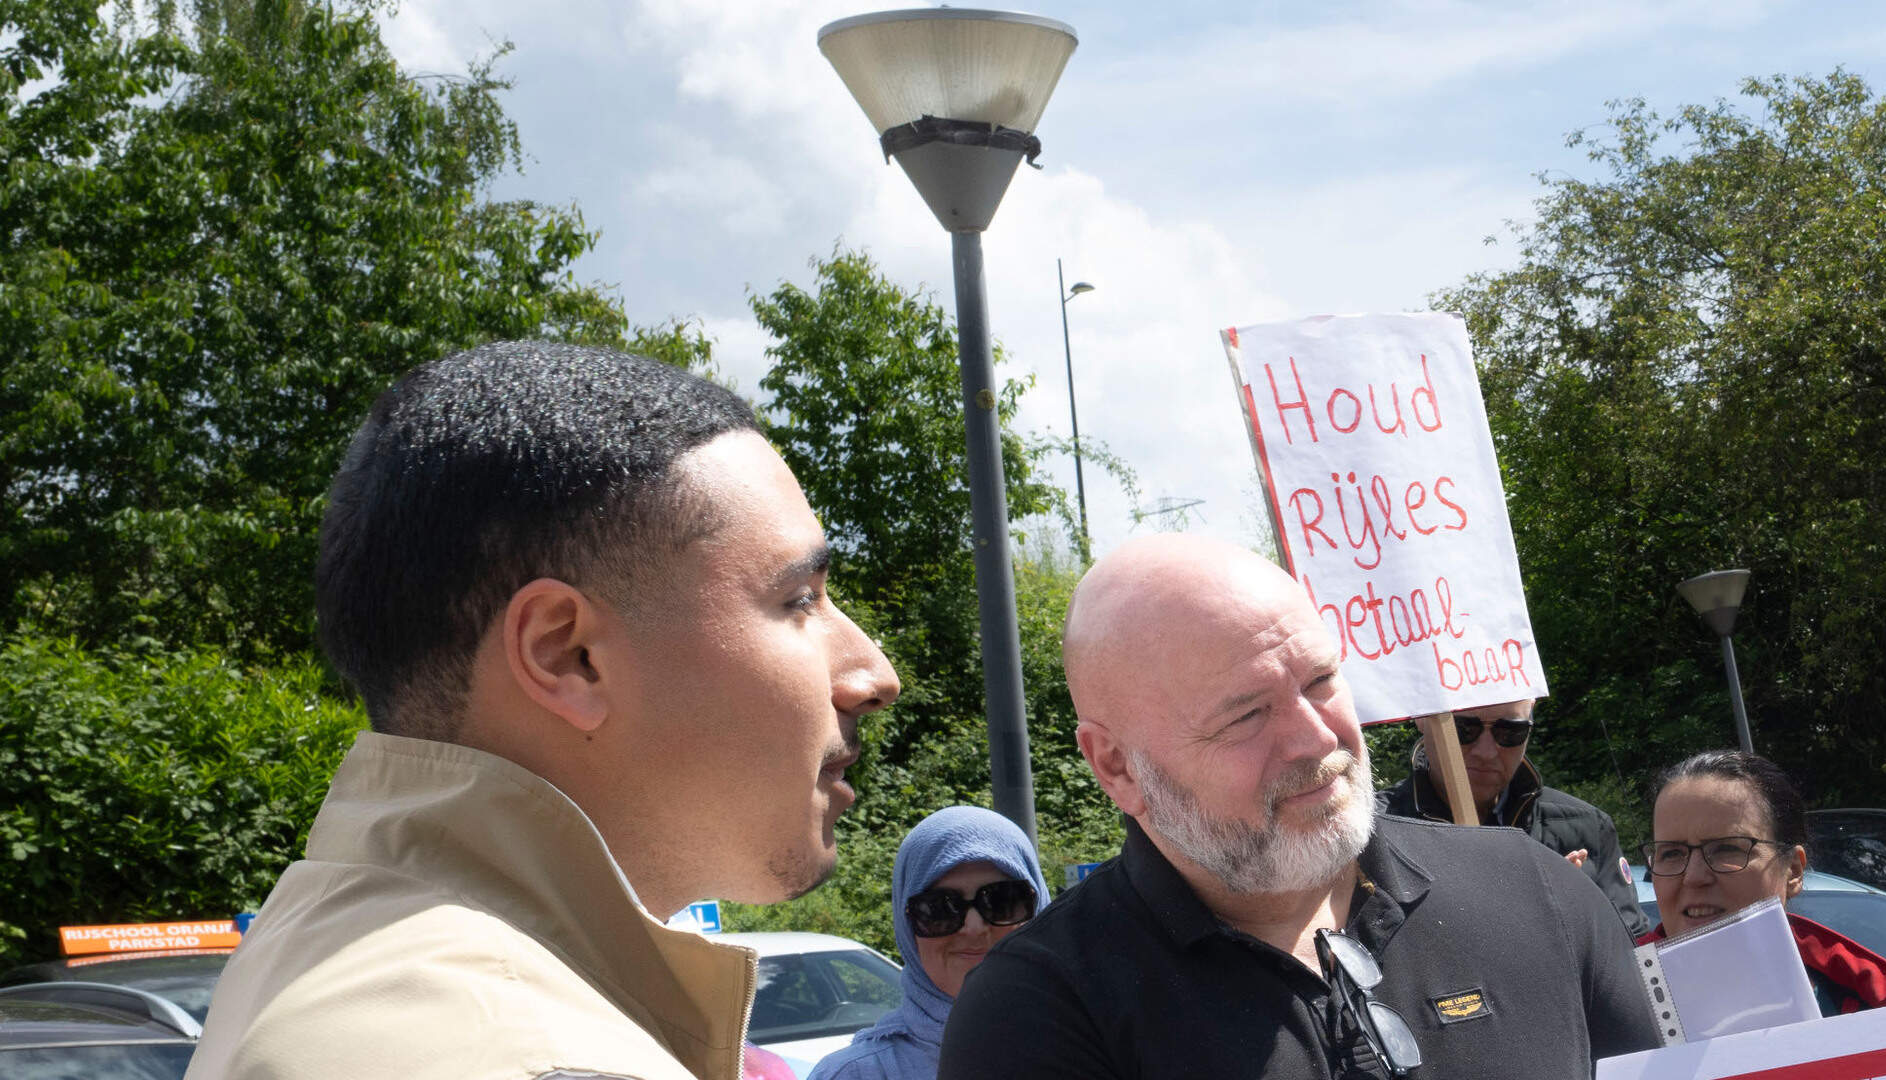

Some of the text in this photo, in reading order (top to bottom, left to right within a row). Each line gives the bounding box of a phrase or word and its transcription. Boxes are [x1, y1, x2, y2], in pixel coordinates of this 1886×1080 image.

[1264, 353, 1442, 445] Houd
[696, 907, 716, 928] L
[65, 925, 164, 940] RIJSCHOOL
[108, 936, 200, 949] PARKSTAD
[1454, 993, 1481, 1004] LEGEND
